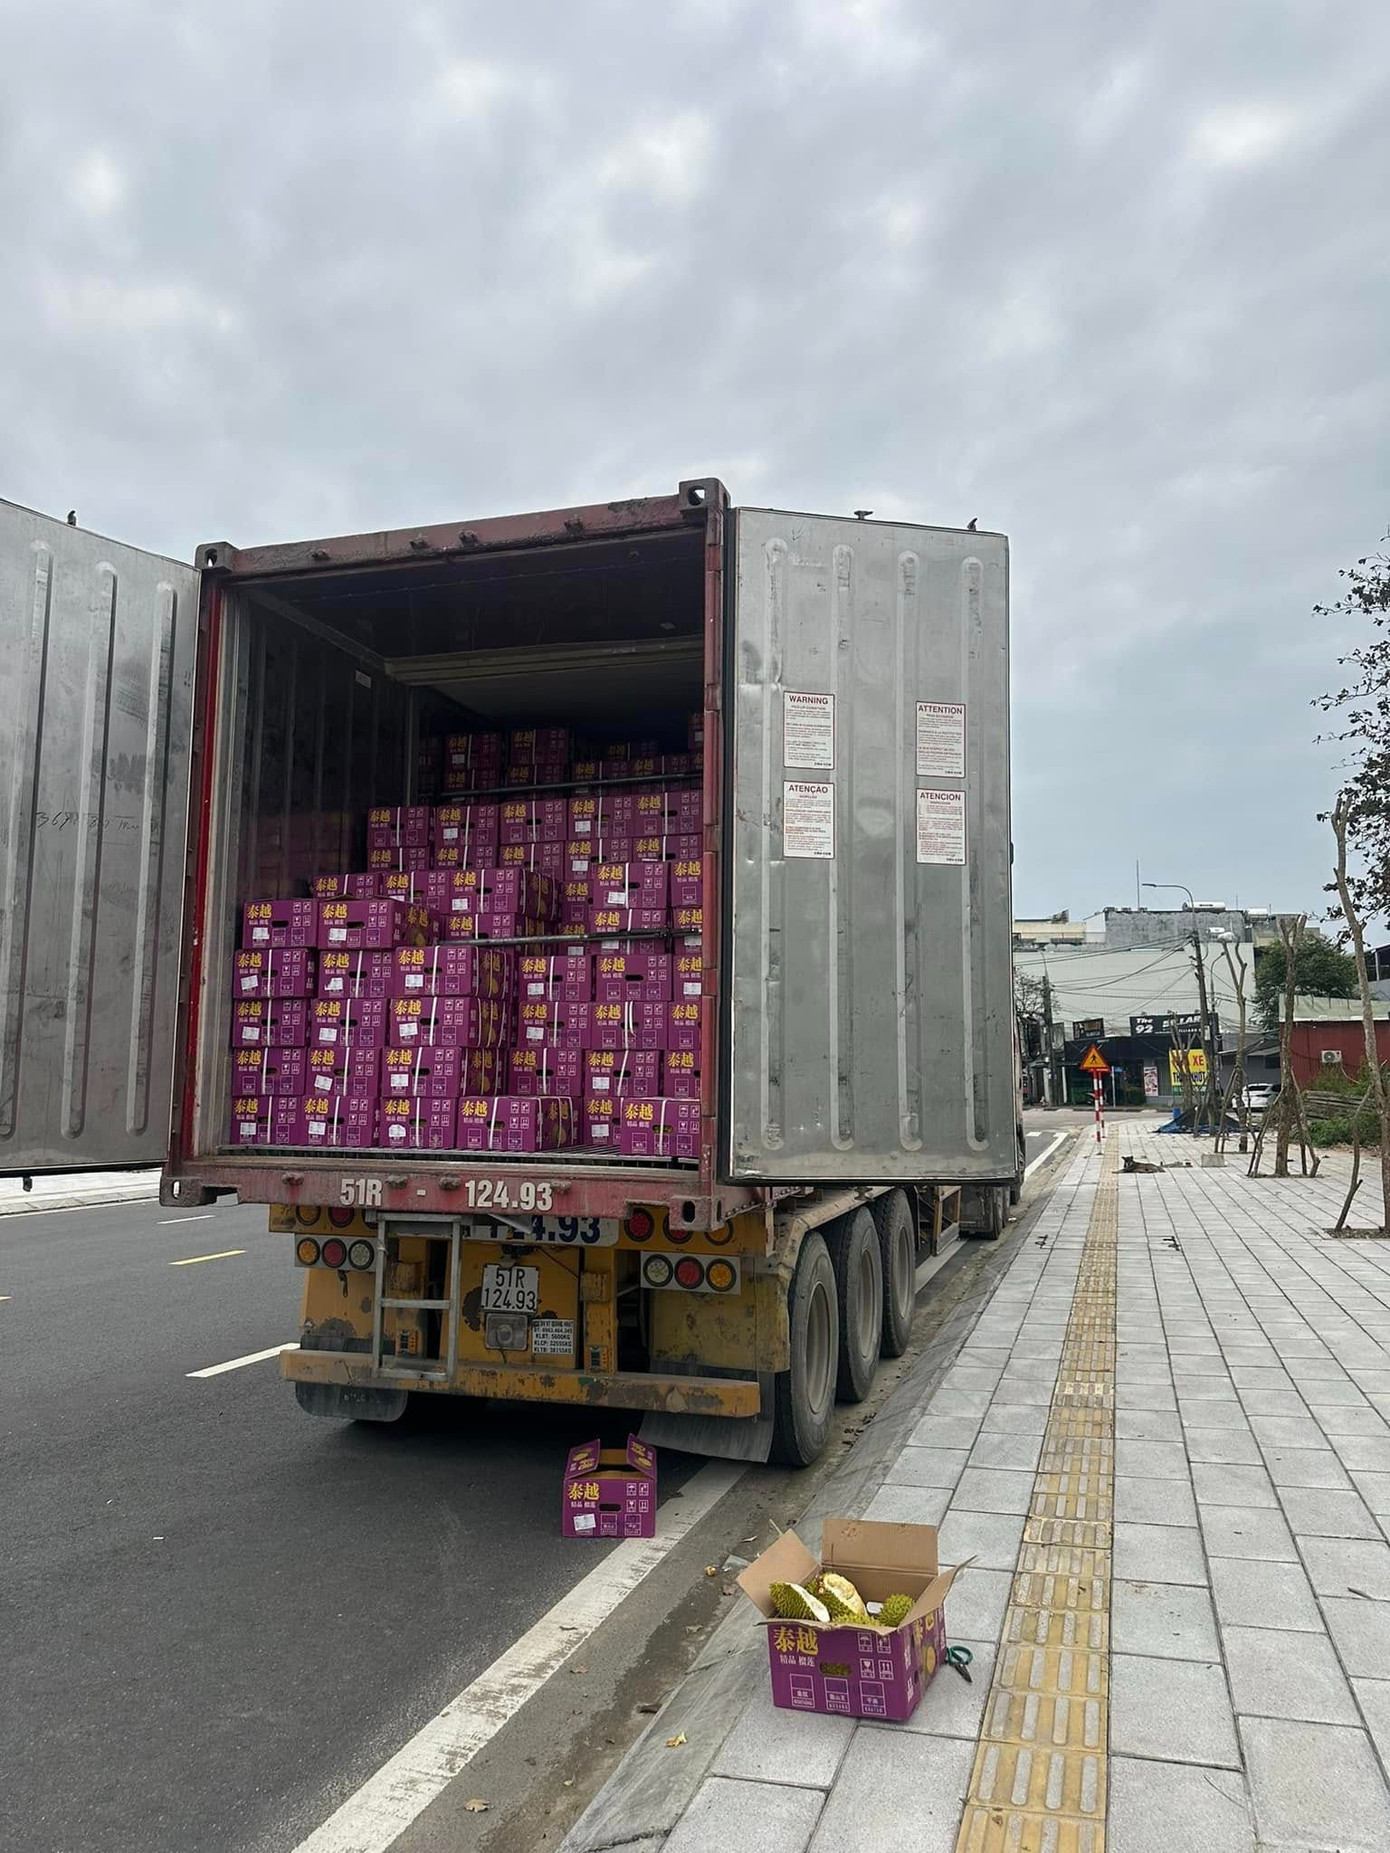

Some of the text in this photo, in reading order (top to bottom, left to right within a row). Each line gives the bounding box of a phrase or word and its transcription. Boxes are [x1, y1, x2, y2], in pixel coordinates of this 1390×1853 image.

[789, 695, 828, 705] WARNING
[918, 704, 963, 714] ATTENTION
[920, 792, 961, 801] ATENCION
[598, 866, 624, 880] 泰越
[675, 862, 701, 876] 泰越
[315, 877, 338, 891] 泰越
[387, 875, 408, 888] 泰越
[453, 872, 476, 886] 泰越
[565, 883, 588, 896] 泰越
[248, 904, 272, 919] 泰越
[322, 904, 348, 919] 泰越
[595, 912, 620, 926] 泰越
[450, 917, 472, 931] 泰越
[238, 952, 262, 968] 泰越
[324, 953, 350, 968] 泰越
[398, 950, 424, 964] 泰越
[600, 957, 625, 972] 泰越
[522, 959, 546, 972] 泰越
[238, 1002, 261, 1016] 泰越
[315, 1001, 340, 1016] 泰越
[394, 999, 421, 1014] 泰越
[523, 1004, 547, 1018] 泰越
[596, 1004, 621, 1019] 泰越
[672, 1004, 698, 1019] 泰越
[1135, 1024, 1153, 1034] 92
[237, 1050, 261, 1065] 泰越
[310, 1051, 334, 1065] 泰越
[387, 1050, 412, 1065] 泰越
[512, 1052, 536, 1066] 泰越
[588, 1052, 614, 1067] 泰越
[668, 1052, 694, 1067] 泰越
[1192, 1055, 1204, 1066] XE
[235, 1099, 258, 1114] 泰越
[304, 1099, 328, 1113] 泰越
[385, 1100, 410, 1115] 泰越
[462, 1101, 487, 1117] 泰越
[588, 1100, 612, 1114] 泰越
[625, 1104, 653, 1120] 泰越
[340, 1178, 383, 1206] 51R
[465, 1179, 553, 1211] 124.93
[495, 1268, 525, 1289] 51R
[485, 1288, 536, 1310] 124.93
[568, 1482, 600, 1501] 泰越
[774, 1626, 818, 1655] 泰越
